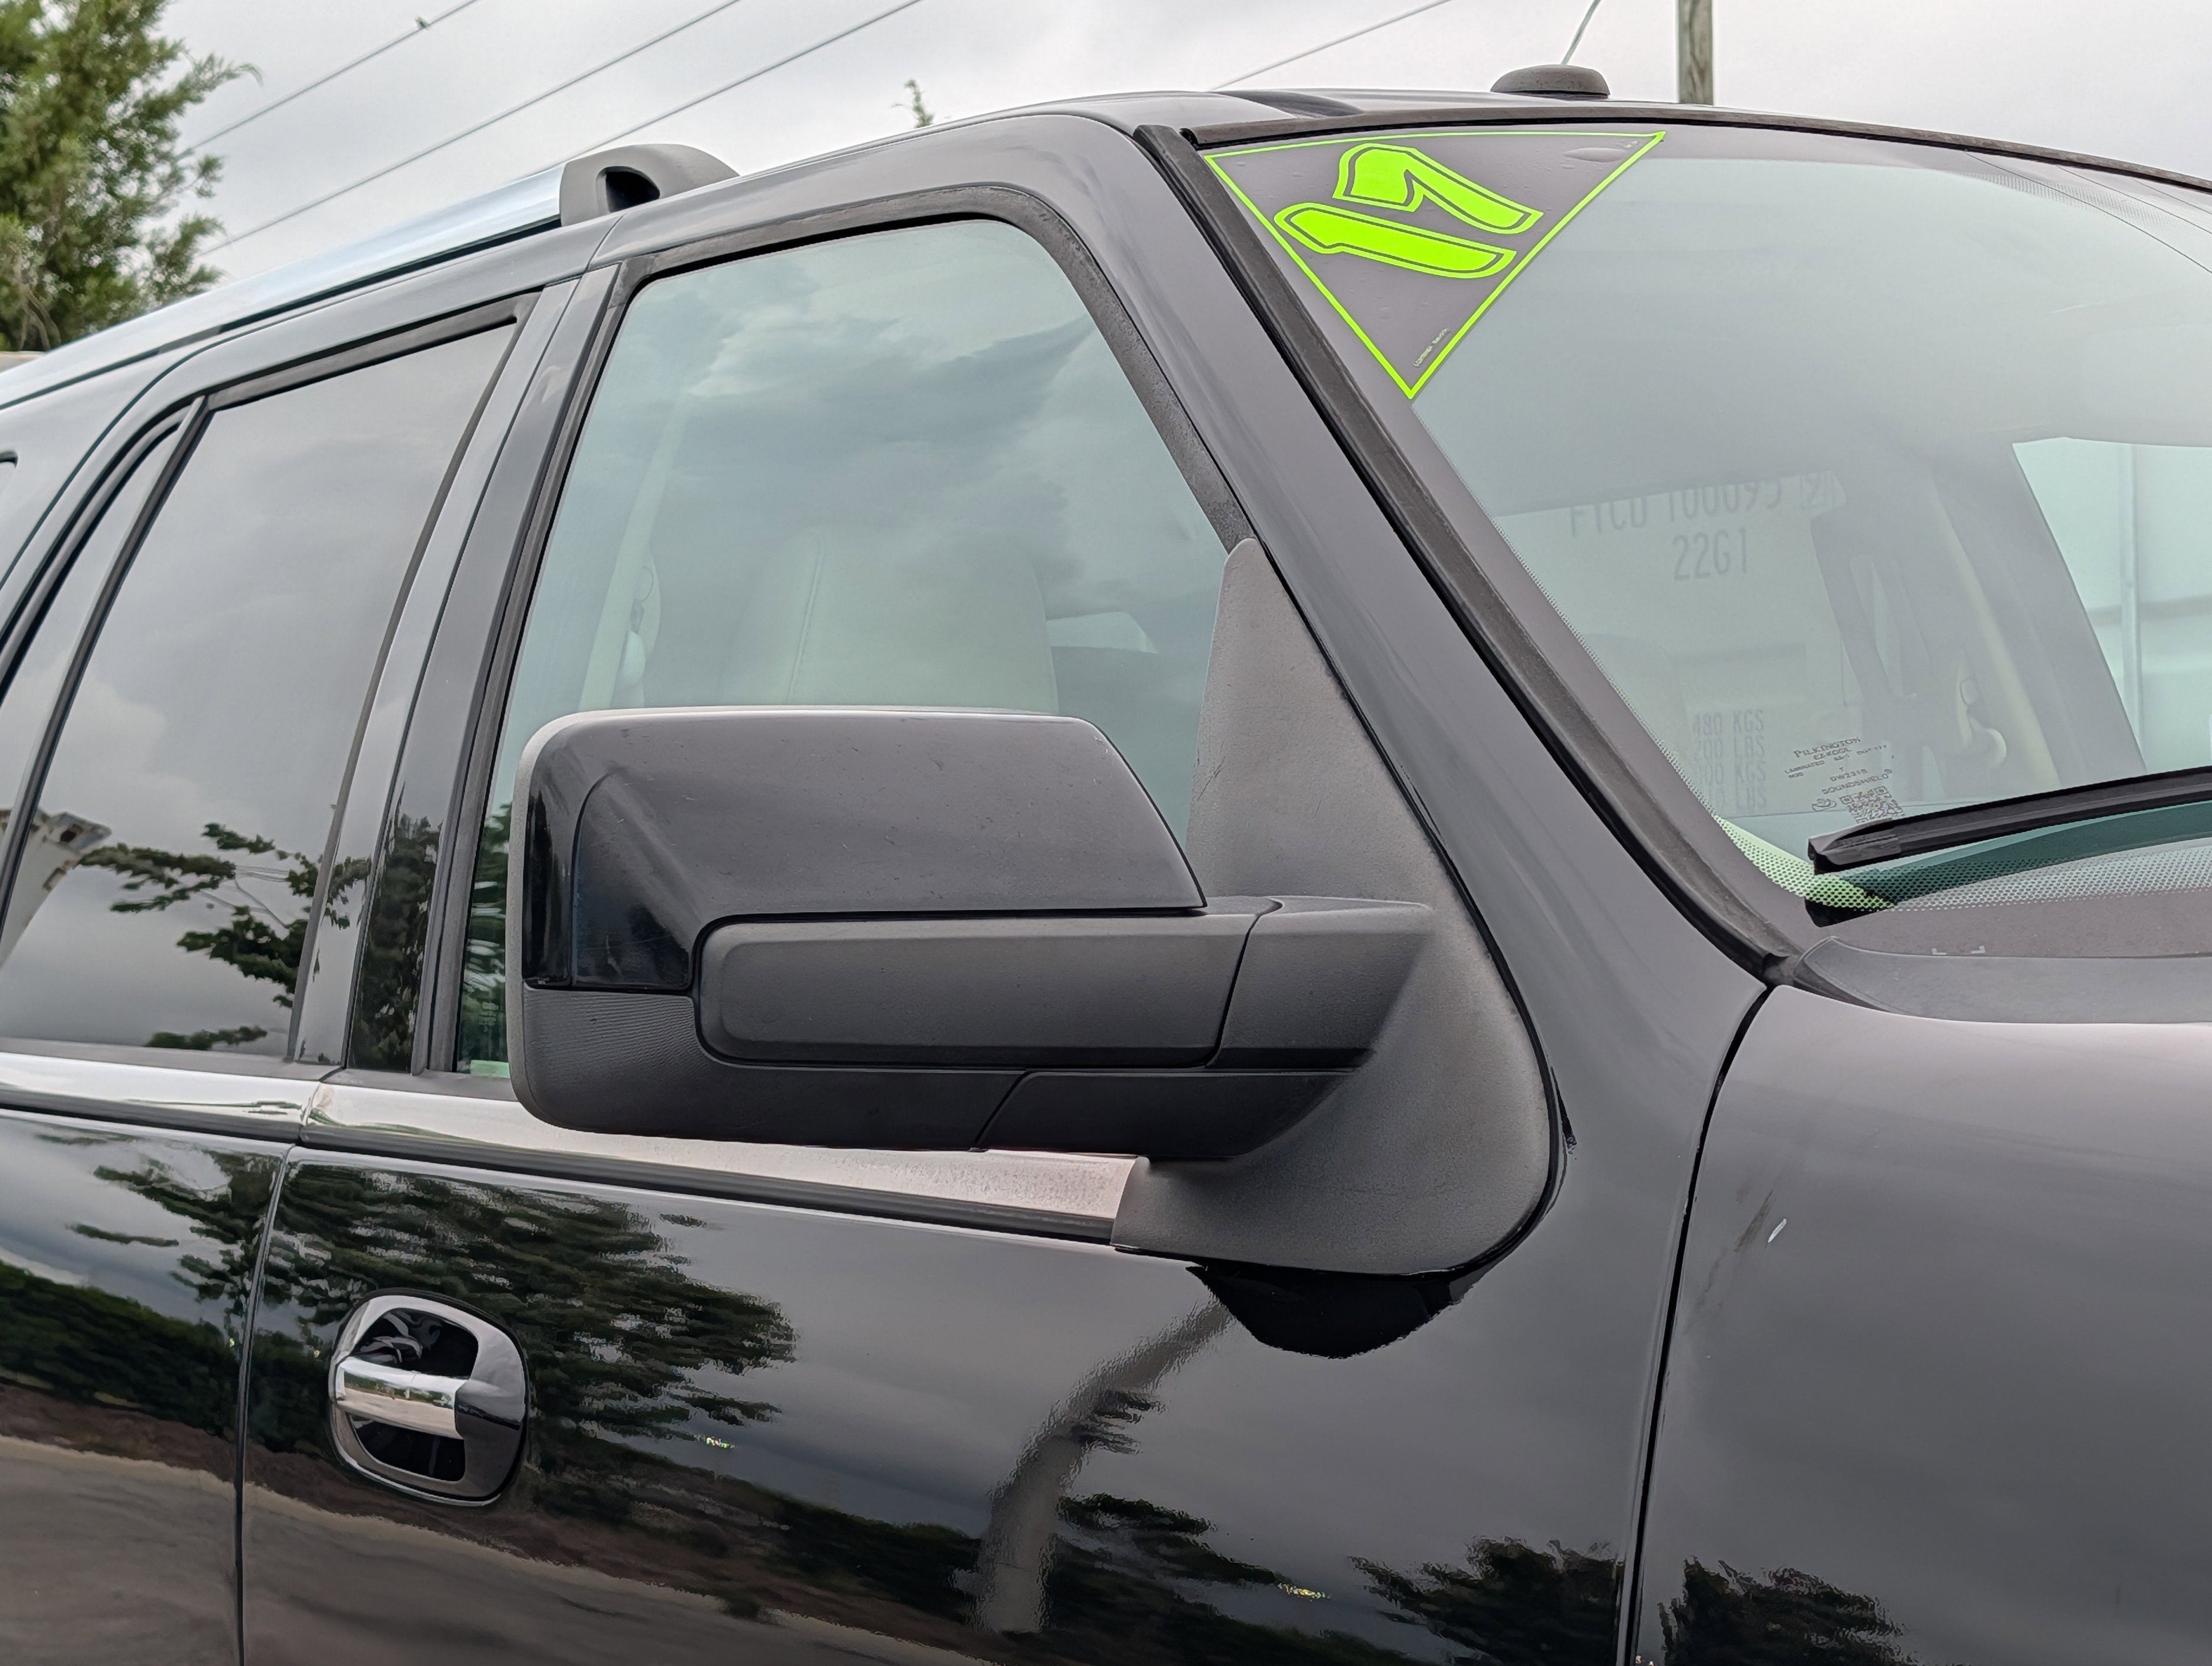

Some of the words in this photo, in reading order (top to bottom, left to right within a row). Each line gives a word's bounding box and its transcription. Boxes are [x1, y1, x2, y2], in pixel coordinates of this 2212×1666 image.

[1274, 143, 1544, 279] 17
[1672, 526, 1747, 580] 22G1
[1733, 709, 1764, 733] KGS
[1734, 735, 1765, 758] LBS
[1793, 737, 1861, 758] PILKINGTON
[1735, 760, 1766, 783] KGS
